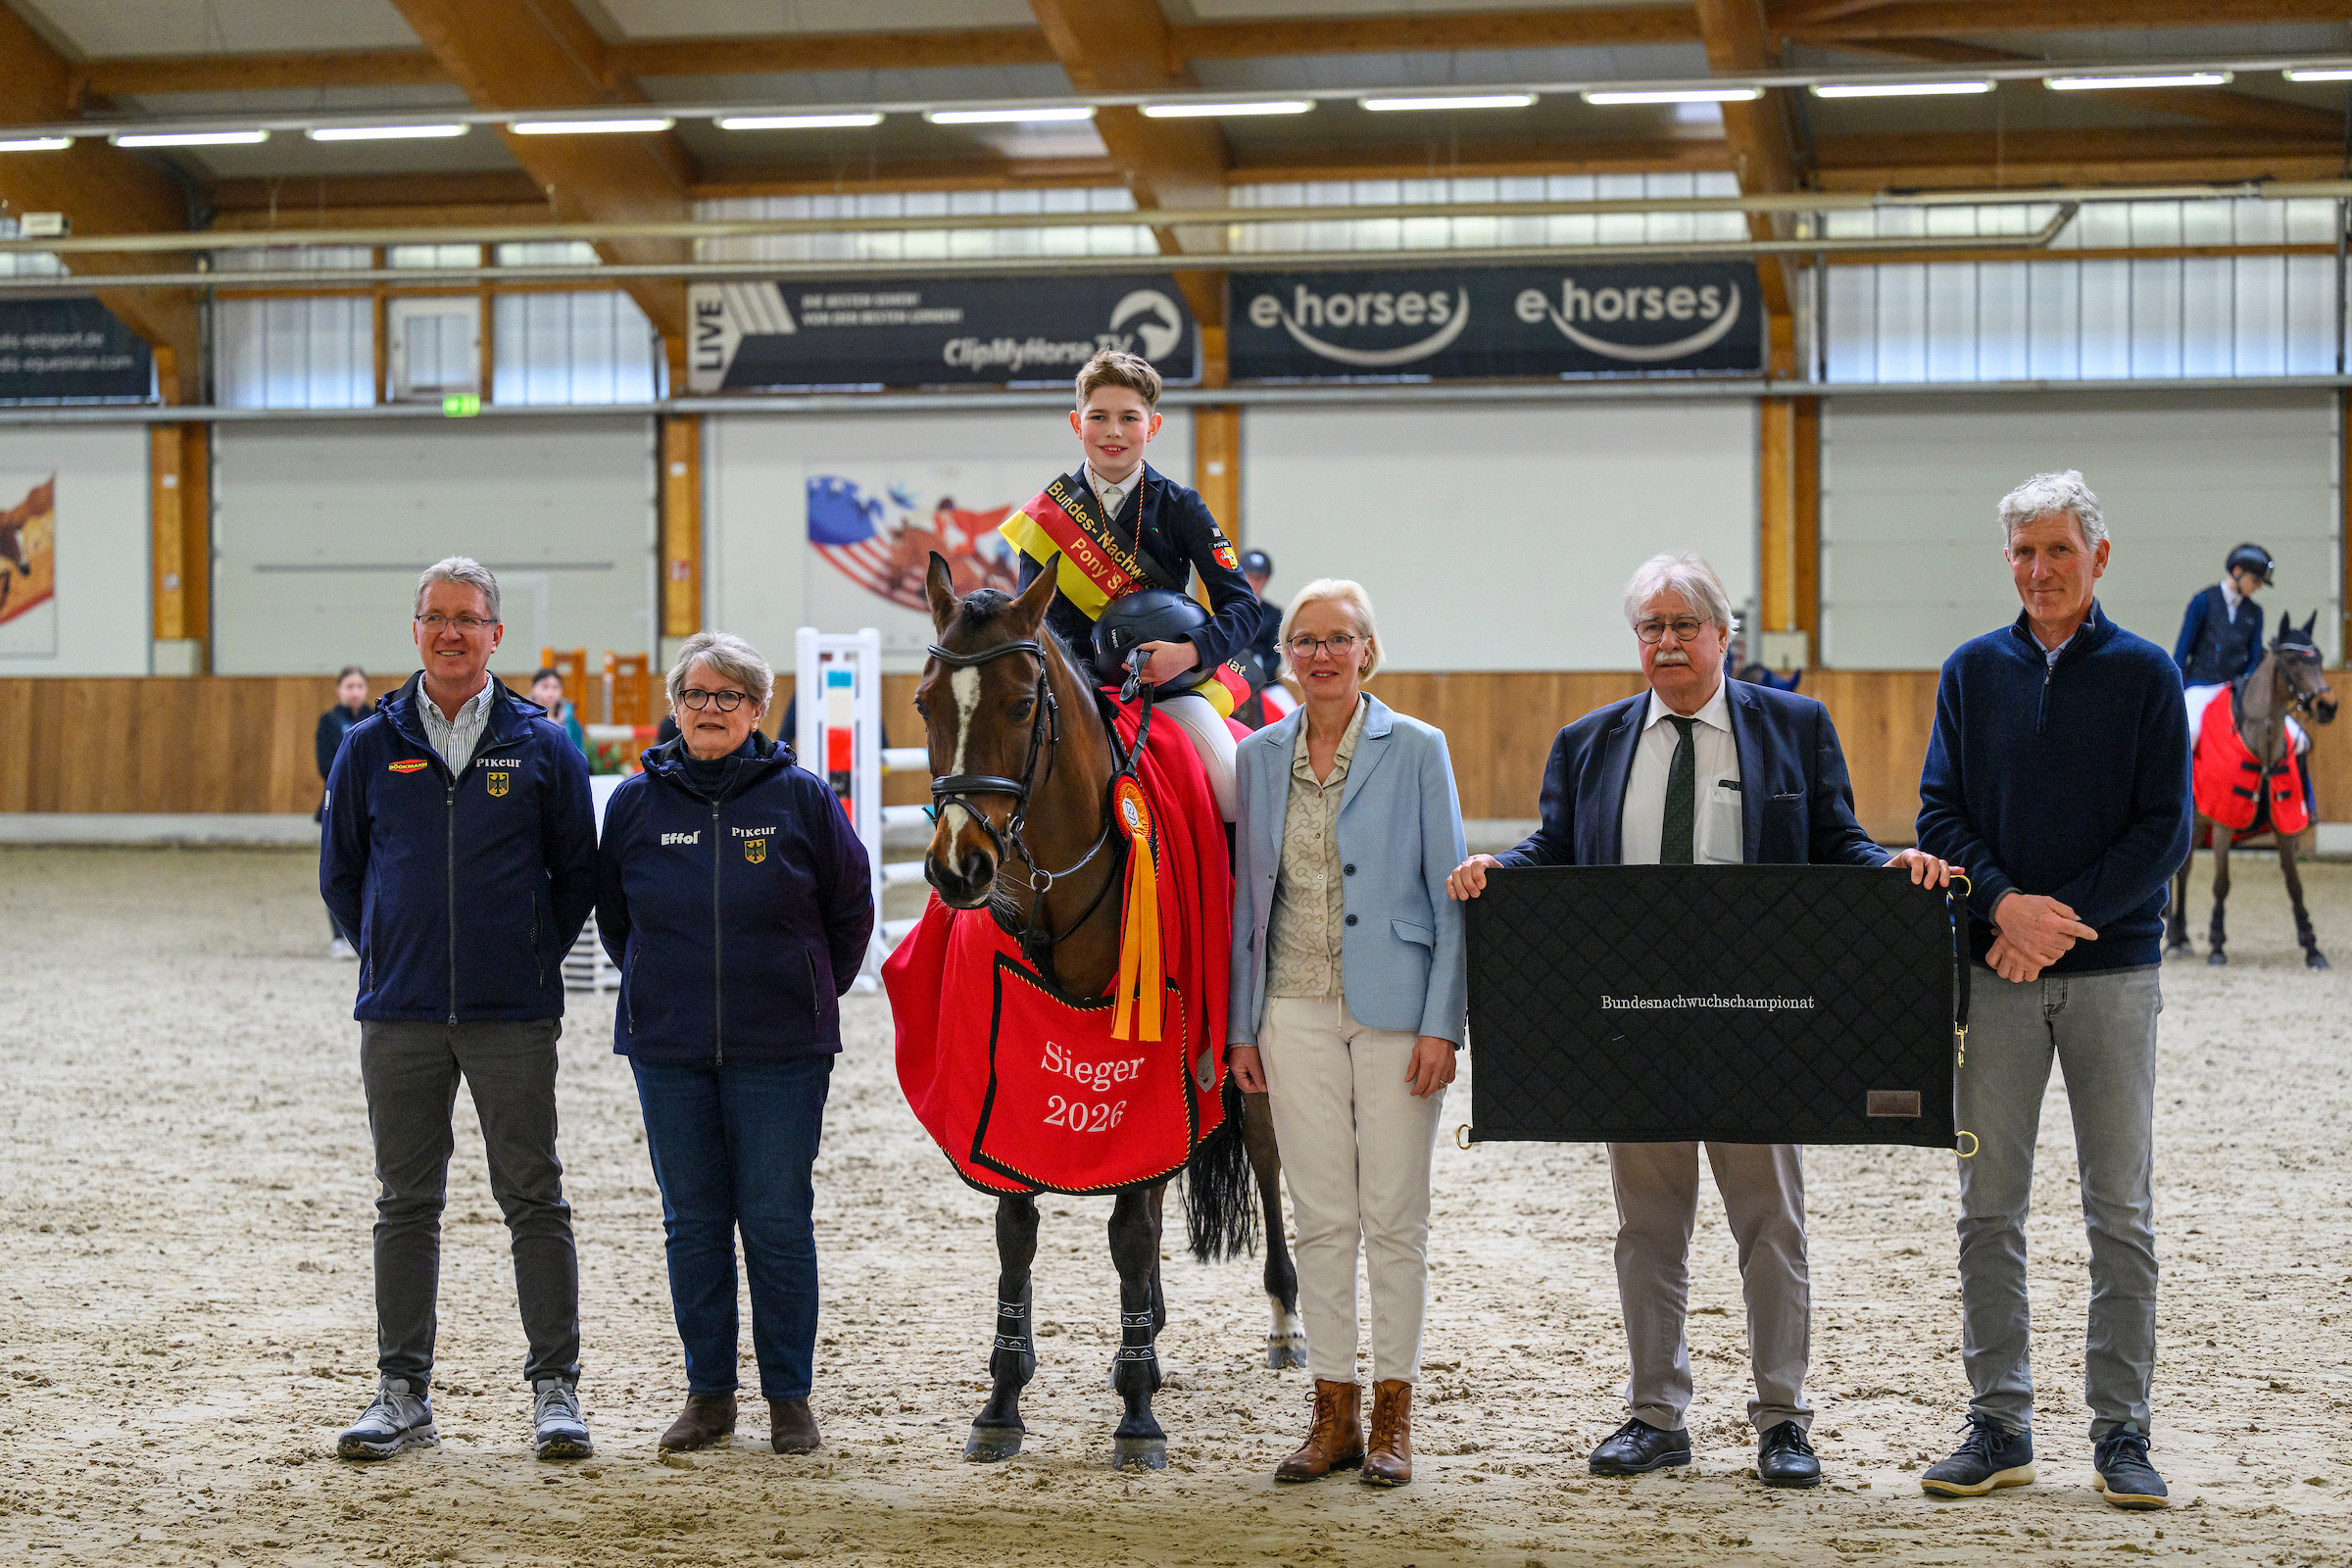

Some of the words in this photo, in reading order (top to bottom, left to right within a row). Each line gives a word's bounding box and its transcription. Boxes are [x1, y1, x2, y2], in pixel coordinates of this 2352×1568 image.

[697, 300, 723, 371] LIVE
[1048, 480, 1098, 534] Bundes-
[1097, 530, 1164, 590] Nachwuc
[1070, 537, 1108, 578] Pony
[1601, 994, 1815, 1012] Bundesnachwuchschampionat
[1041, 1041, 1146, 1092] Sieger
[1043, 1095, 1127, 1133] 2026
